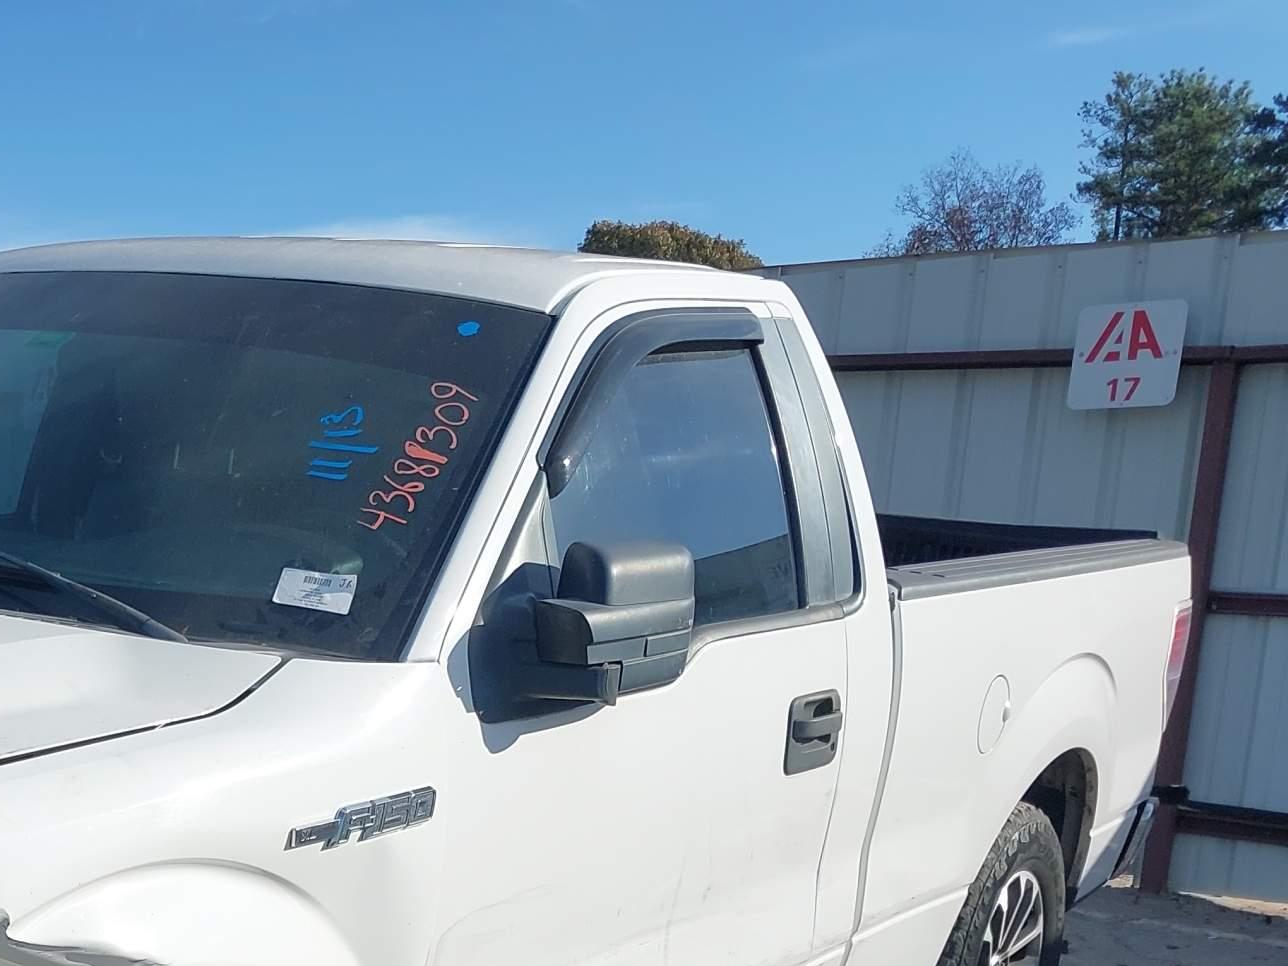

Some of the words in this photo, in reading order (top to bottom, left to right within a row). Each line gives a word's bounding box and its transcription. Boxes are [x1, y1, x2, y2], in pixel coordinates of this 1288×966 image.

[1106, 377, 1141, 402] 17
[307, 406, 379, 481] 11/13
[357, 382, 479, 530] 43681309
